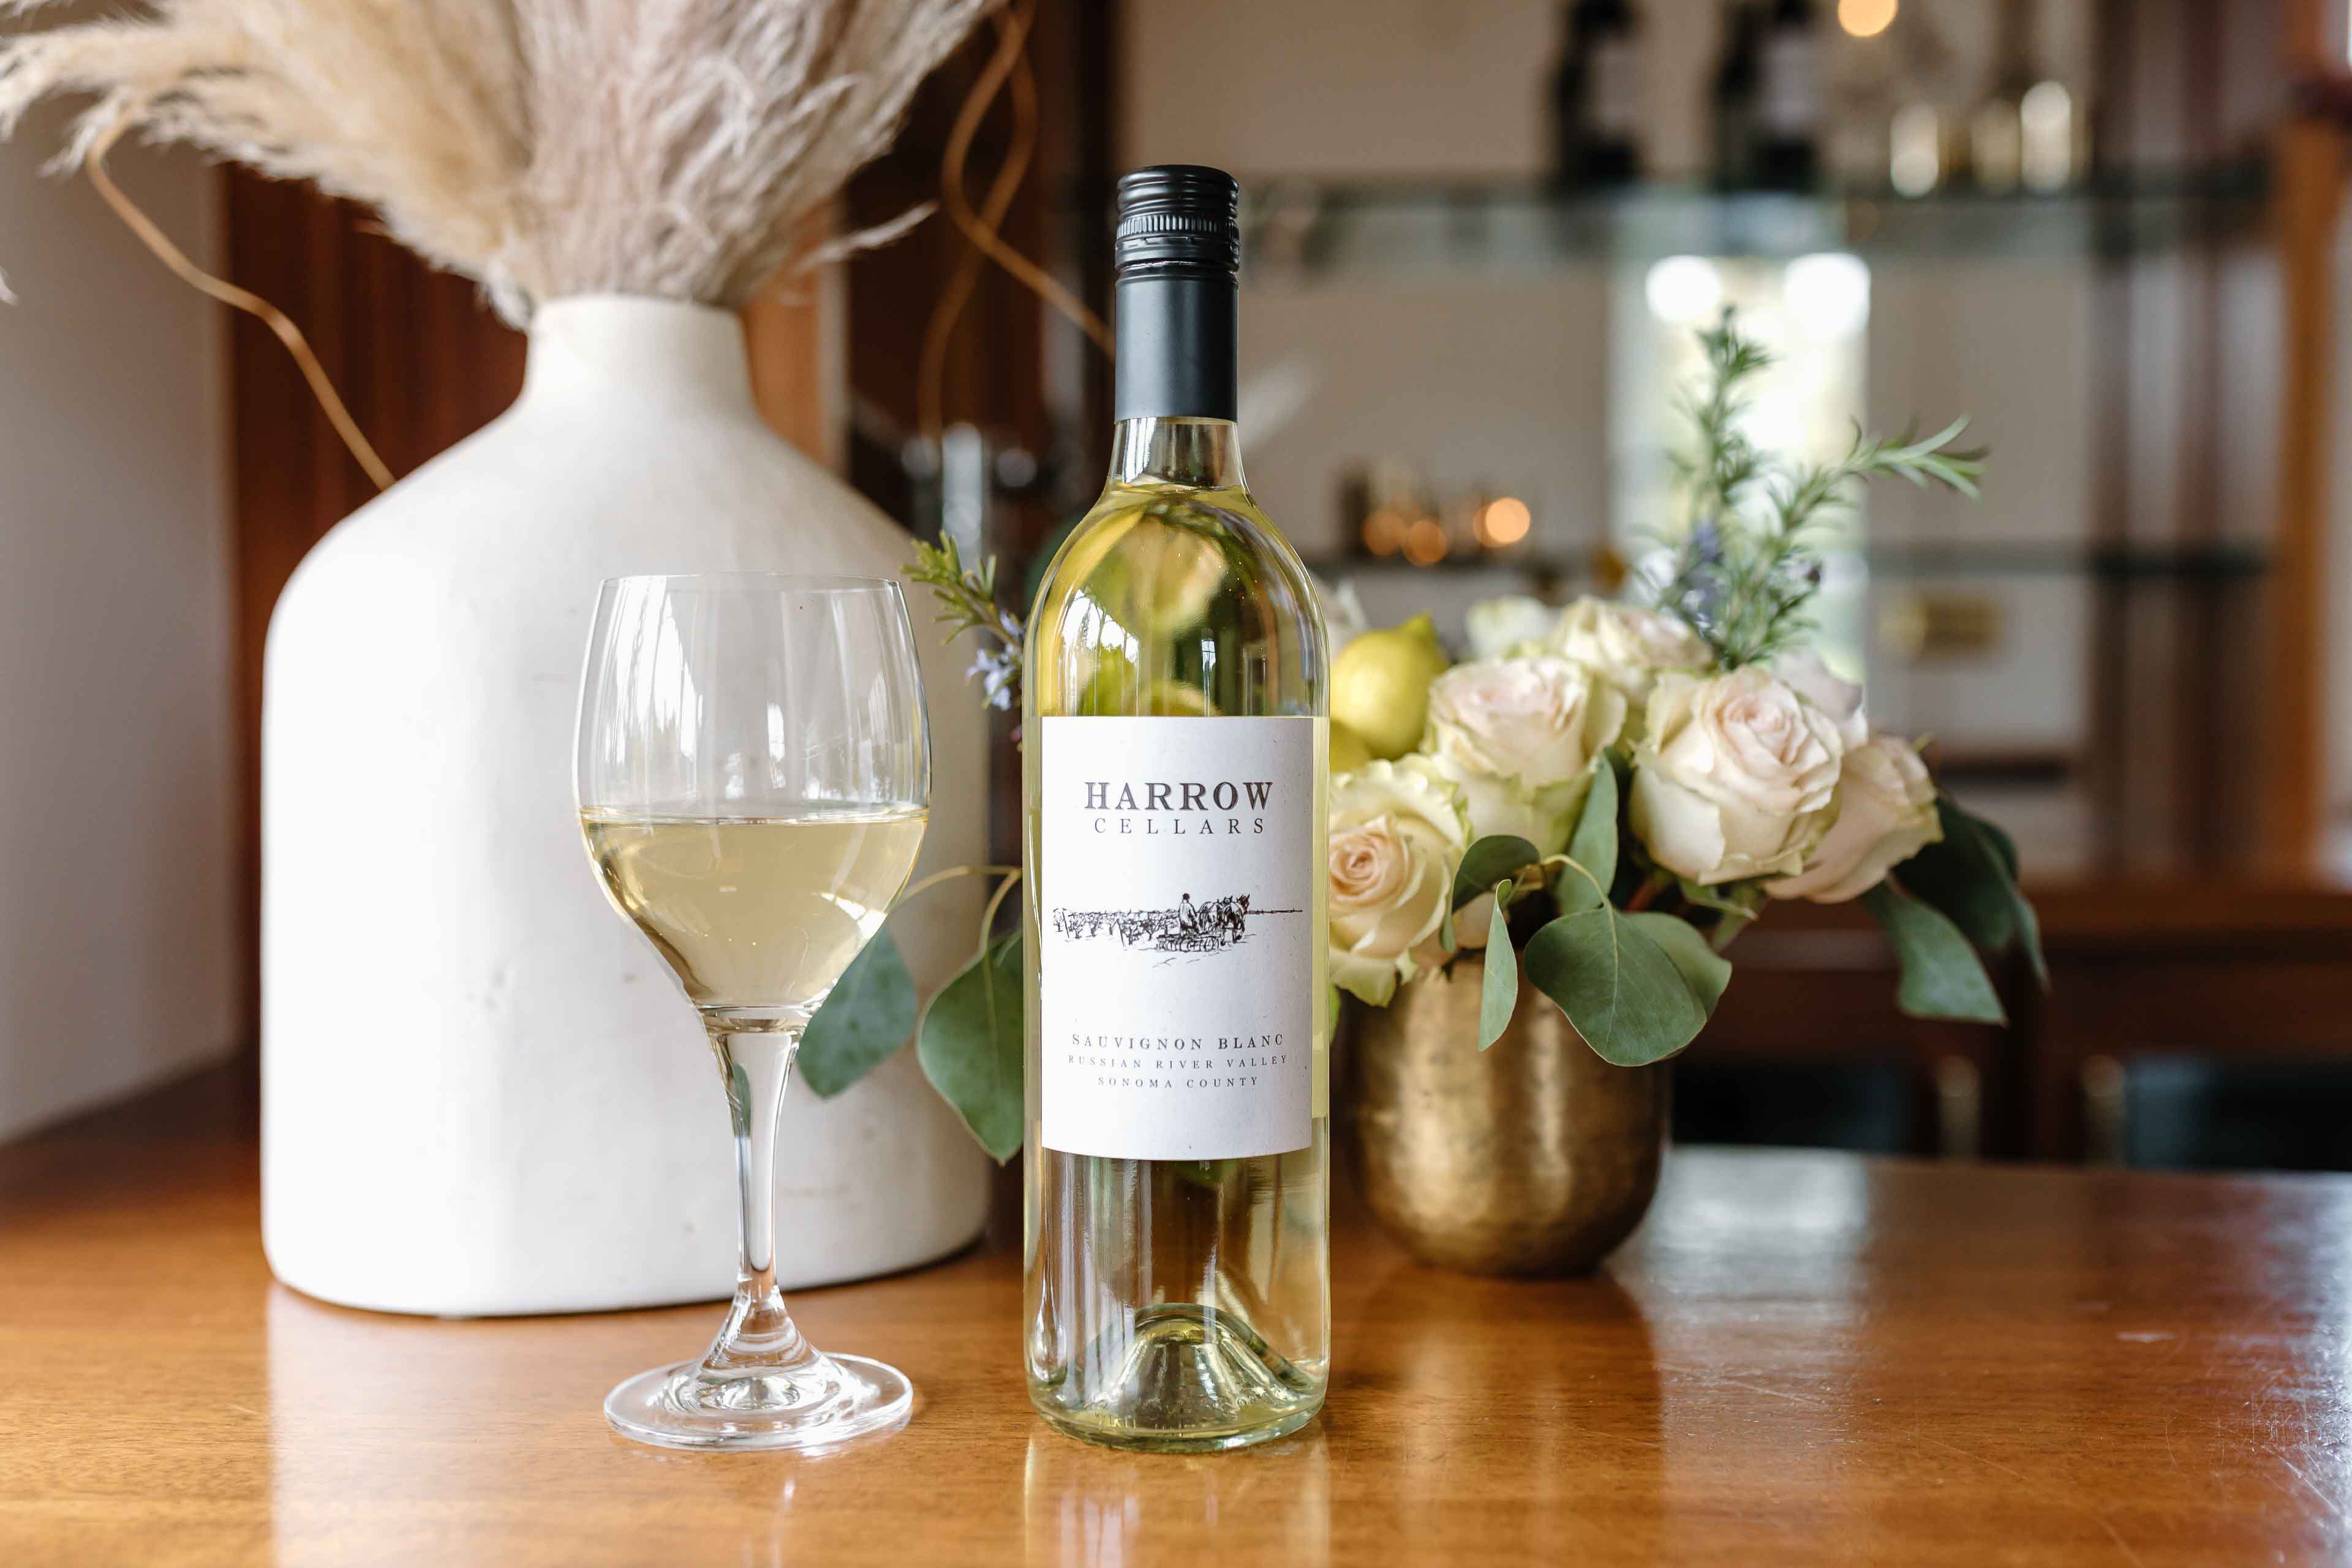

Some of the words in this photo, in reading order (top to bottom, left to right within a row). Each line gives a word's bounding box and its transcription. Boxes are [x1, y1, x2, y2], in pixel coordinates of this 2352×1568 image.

[1084, 782, 1273, 811] HARROW
[1094, 818, 1264, 835] CELLARS
[1072, 1033, 1202, 1050] SAUVIGNON
[1218, 1033, 1283, 1049] BLANC
[1068, 1055, 1141, 1068] RUSSIAN
[1156, 1060, 1213, 1069] RIVER
[1226, 1054, 1287, 1068] VALLEY
[1098, 1077, 1172, 1088] SONOMA
[1186, 1076, 1257, 1088] COUNTY
